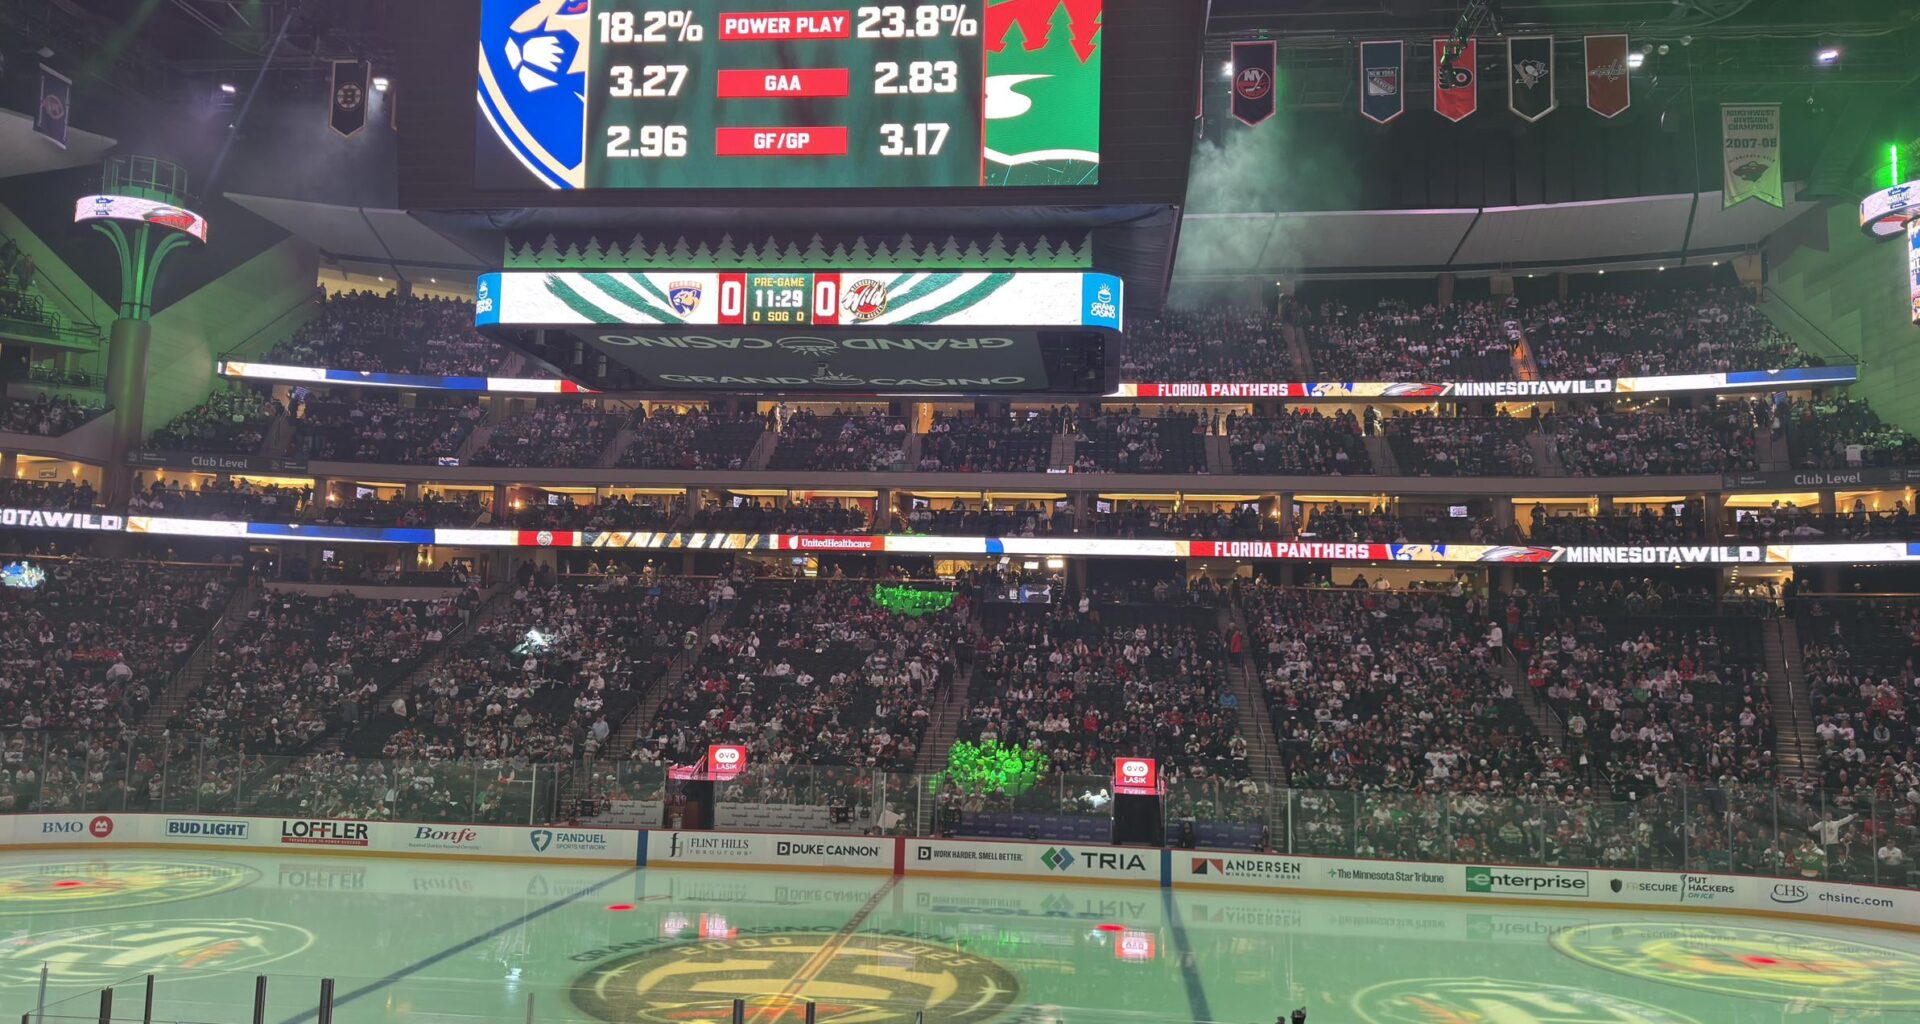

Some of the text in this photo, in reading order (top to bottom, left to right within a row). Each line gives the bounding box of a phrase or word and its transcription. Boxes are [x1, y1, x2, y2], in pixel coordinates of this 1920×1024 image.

[598, 5, 977, 44] 18.2% POWER PLAY 23.8%
[609, 61, 957, 97] 3.27 GAA 2.83
[607, 123, 950, 158] 2.96 GF/GP 3.17
[1726, 138, 1777, 148] 2007-08
[754, 278, 805, 287] PRE-GAME
[722, 281, 741, 316] 0
[755, 290, 803, 307] 11:29
[816, 281, 836, 316] 0
[752, 312, 804, 322] 0 SOG 0
[599, 334, 1014, 351] GRAND CASINO
[659, 373, 1026, 387] GRAND CASINO
[1158, 383, 1289, 397] FLORIDA PANTHERS
[191, 456, 248, 469] Club Level
[1794, 472, 1861, 485] Club Level
[801, 538, 872, 548] UnitedHealthcare
[1214, 541, 1369, 559] FLORIDA PANTHERS
[42, 822, 83, 833] BMO
[168, 822, 246, 837] BUD LIGHT
[282, 821, 368, 839] LOFFLER
[414, 826, 477, 843] Bonfe
[557, 833, 606, 843] FANDUEL
[691, 837, 749, 849] FLINT HILLS
[792, 844, 824, 854] DUKE
[826, 845, 878, 856] CANNON
[933, 850, 952, 858] WORK
[952, 851, 977, 859] HARDER.
[978, 852, 997, 860] SMELL
[1081, 852, 1146, 871] TRIA
[1225, 860, 1300, 873] ANDERSEN
[1337, 869, 1444, 883] The Minnesota Star Tribune
[1472, 873, 1586, 890] enterprise
[1688, 876, 1707, 884] PUT
[1688, 884, 1735, 894] HACKERS
[1773, 884, 1805, 897] CHS
[1819, 892, 1893, 908] chsinc.com
[673, 936, 793, 955] 2000
[877, 941, 979, 967] 2025
